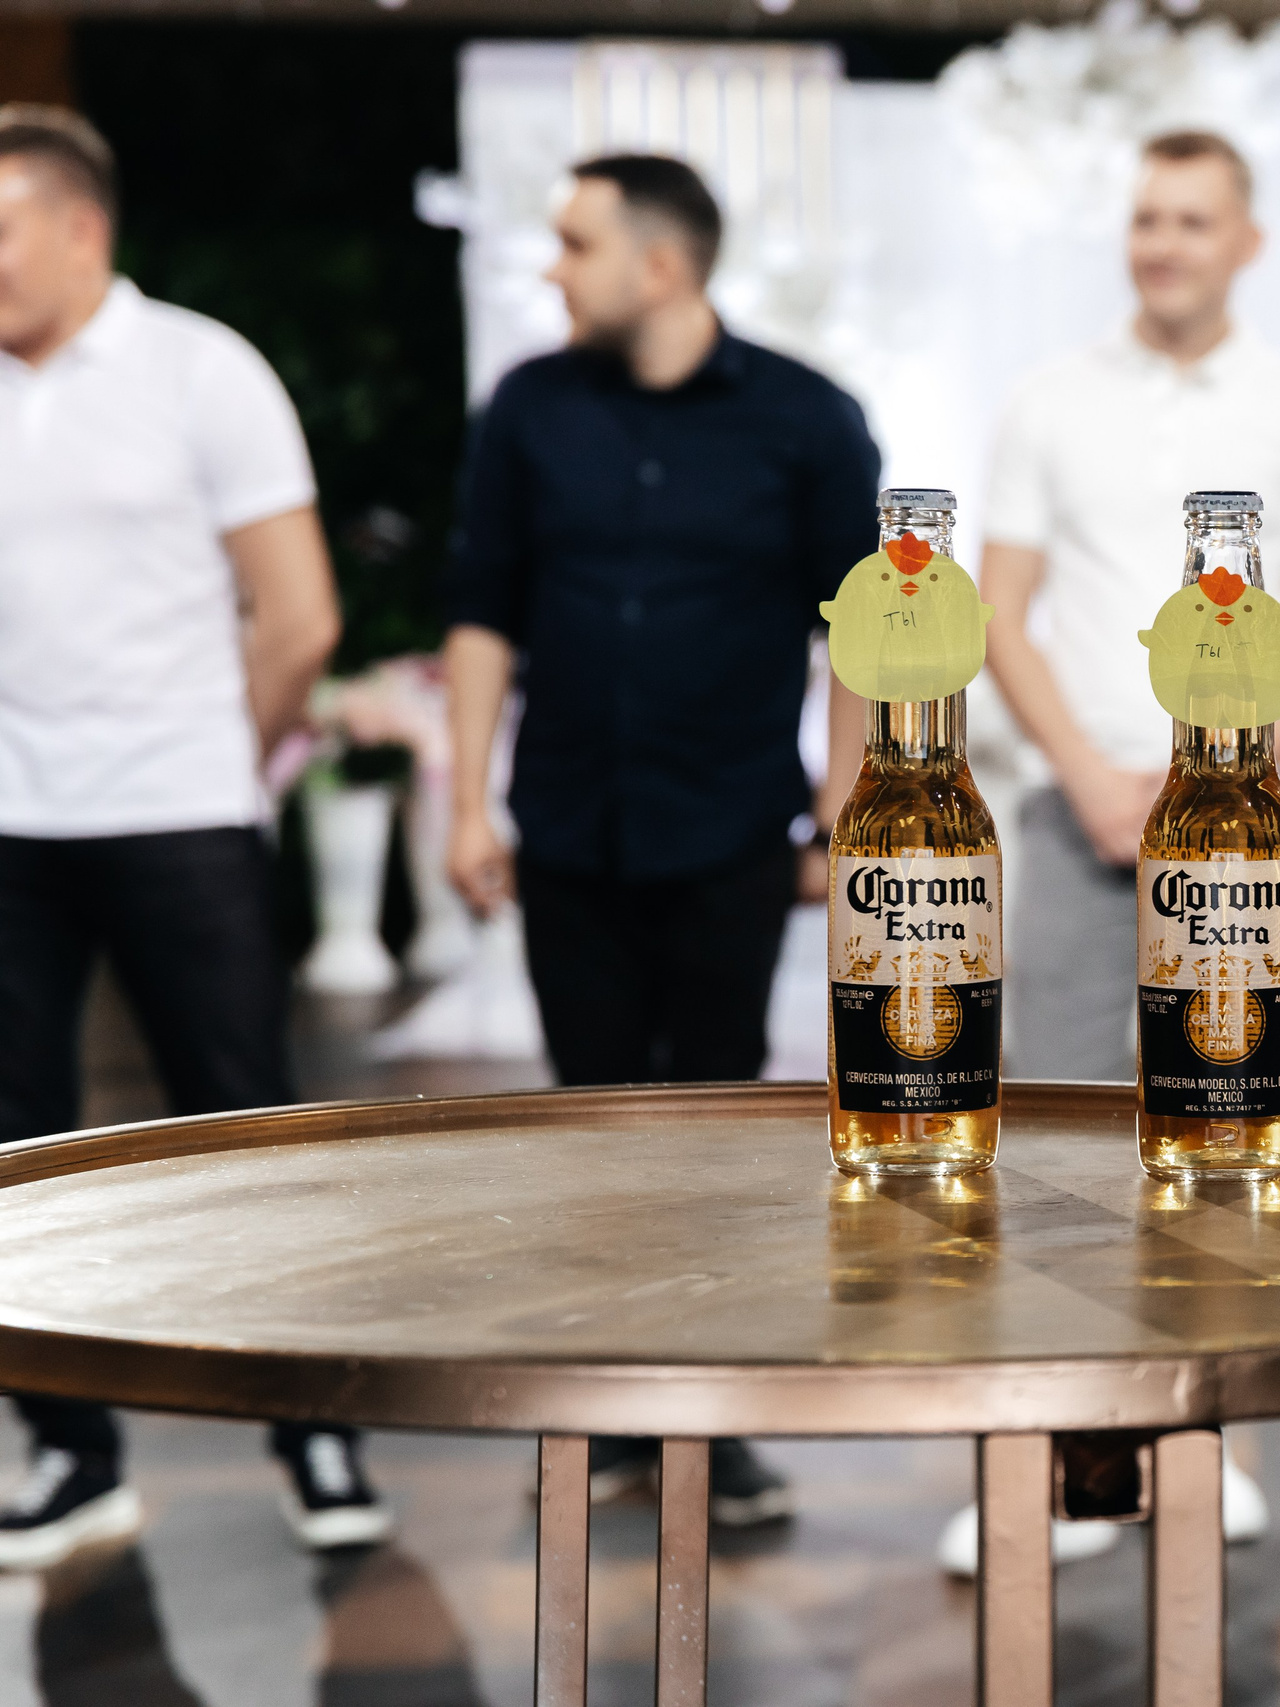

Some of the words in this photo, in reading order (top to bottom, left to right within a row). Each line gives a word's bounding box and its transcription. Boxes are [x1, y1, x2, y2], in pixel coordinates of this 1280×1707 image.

[847, 865, 987, 919] Corona
[885, 911, 966, 941] Extra
[1187, 915, 1270, 945] Extra
[1208, 1040, 1239, 1051] FINA
[846, 1071, 893, 1085] CERVECERIA
[895, 1074, 936, 1086] MODELO,
[937, 1074, 946, 1084] S.
[948, 1073, 958, 1084] DE
[974, 1070, 983, 1081] DE
[1150, 1075, 1196, 1089] CERVECERIA
[1198, 1078, 1239, 1091] MODELO,
[1240, 1079, 1248, 1089] S.
[1250, 1078, 1261, 1088] DE
[905, 1087, 940, 1098] MEXICO
[1208, 1092, 1243, 1103] MEXICO
